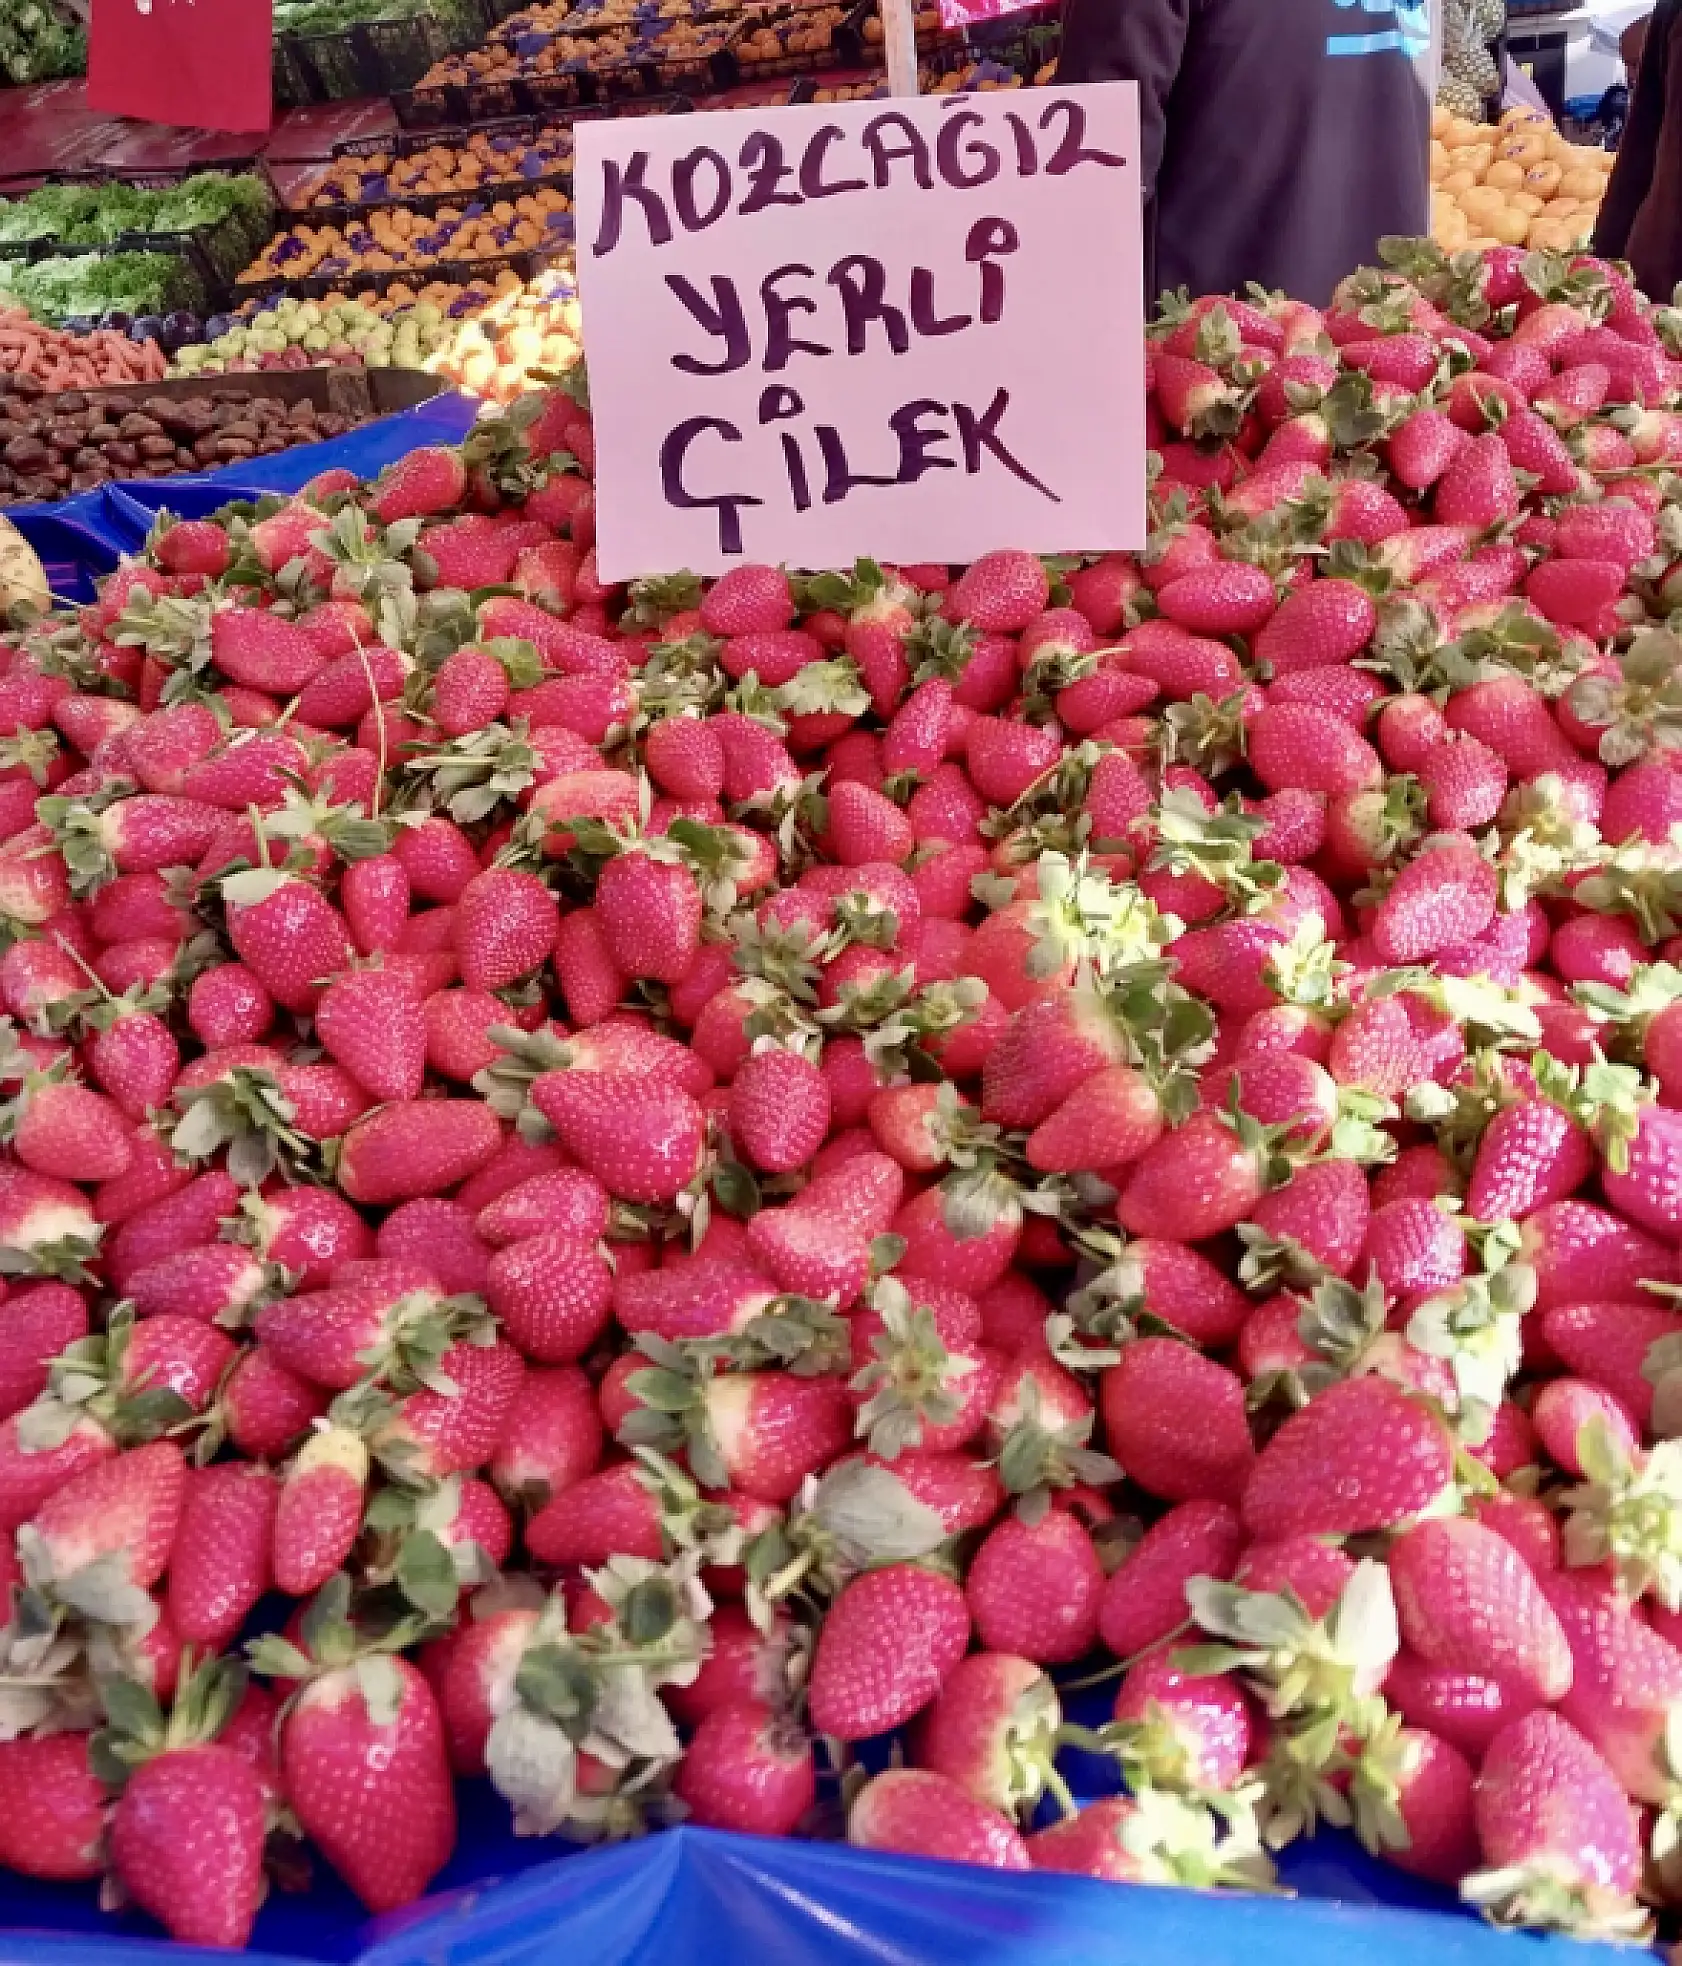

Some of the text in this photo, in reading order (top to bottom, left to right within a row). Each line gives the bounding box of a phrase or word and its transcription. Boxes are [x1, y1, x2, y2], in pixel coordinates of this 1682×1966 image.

[592, 96, 1126, 258] KOZCAĞIZ
[664, 217, 1020, 375] YERLİ
[659, 384, 1060, 553] ÇİLEK
